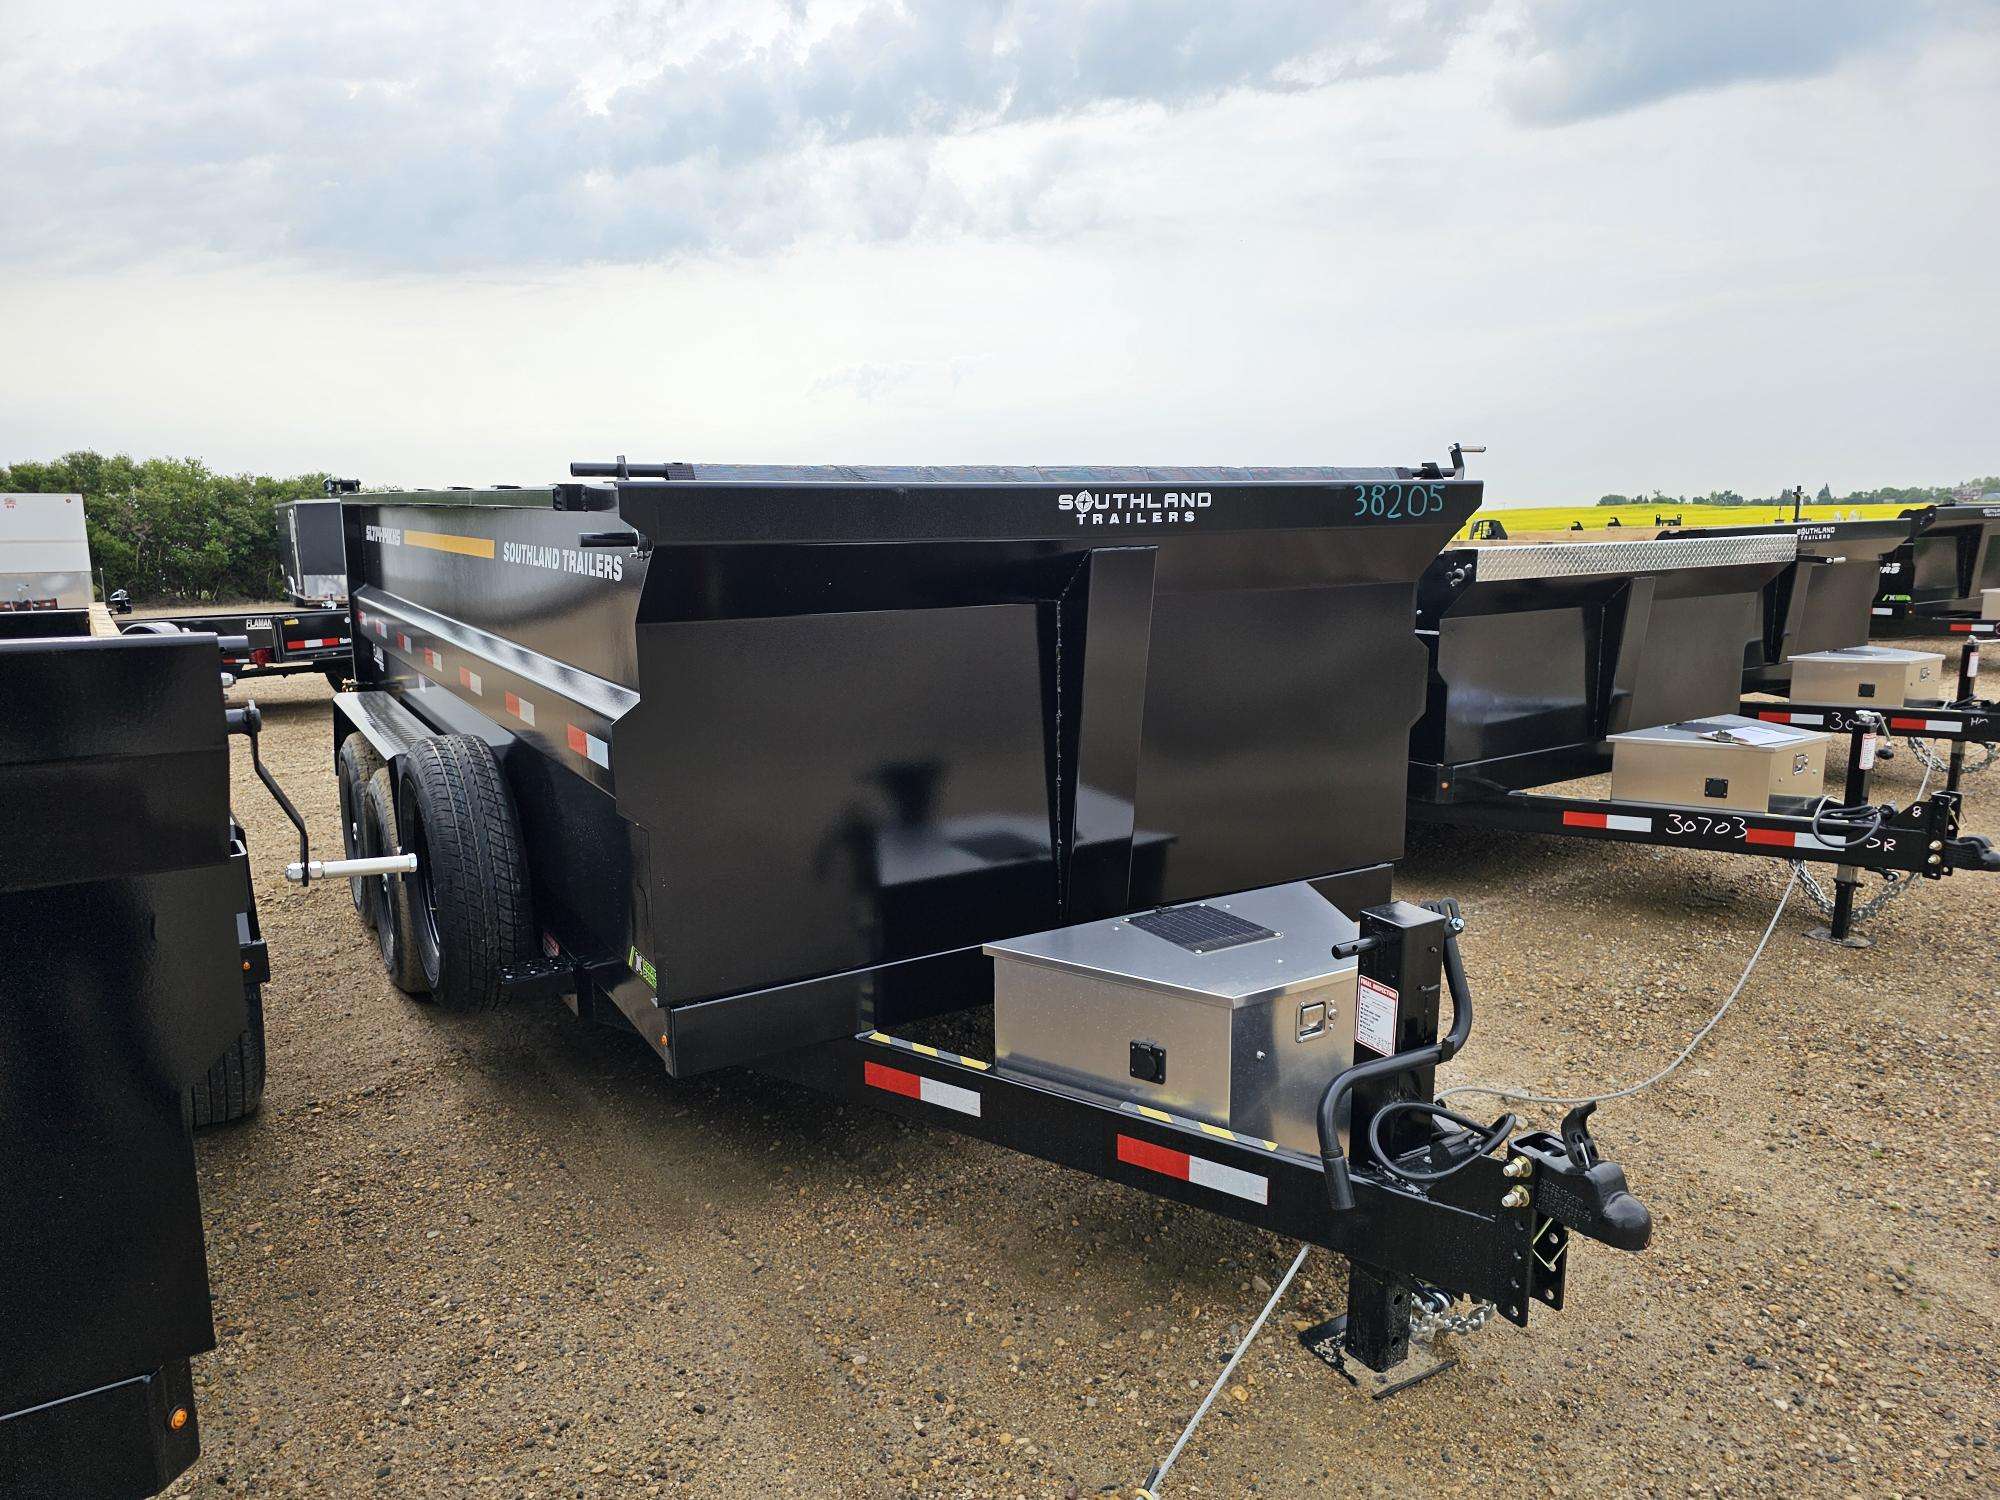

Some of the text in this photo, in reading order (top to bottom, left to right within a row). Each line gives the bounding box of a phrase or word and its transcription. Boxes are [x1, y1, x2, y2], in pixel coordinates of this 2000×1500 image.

[1058, 489, 1212, 514] SOUTHLAND
[1353, 484, 1446, 519] 38205
[1076, 511, 1195, 525] TRAILERS
[1796, 526, 1836, 535] SOUTHLAND
[1800, 533, 1831, 541] TRAILERS
[503, 541, 623, 582] SOUTHLAND TRAILERS
[1911, 805, 1922, 818] 8
[1665, 813, 1748, 839] 30703
